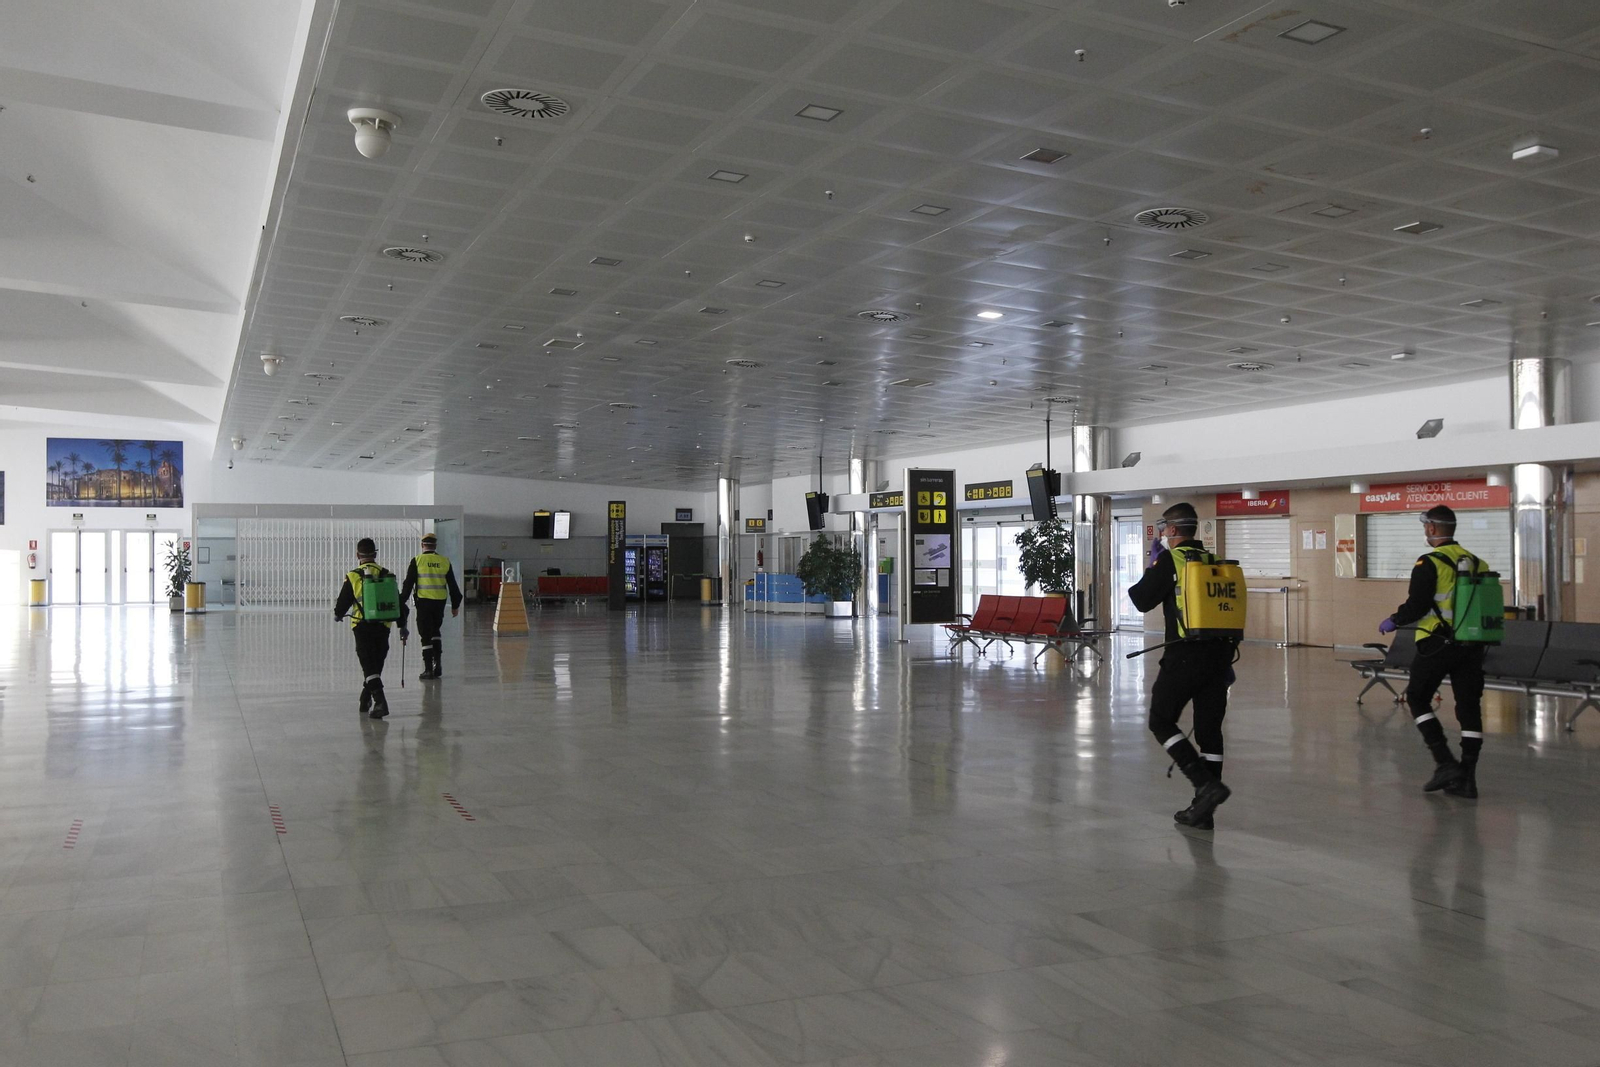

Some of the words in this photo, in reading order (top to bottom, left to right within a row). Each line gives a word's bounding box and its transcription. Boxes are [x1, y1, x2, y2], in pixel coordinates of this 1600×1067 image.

[1406, 483, 1439, 493] SERVICIO
[1440, 482, 1451, 492] DE
[1365, 491, 1401, 504] easyJet
[1406, 491, 1445, 503] ATENCIÓN
[1444, 492, 1455, 501] AL
[1456, 490, 1489, 501] CLIENTE
[1206, 582, 1237, 599] UME
[377, 602, 396, 611] UME
[1481, 615, 1505, 630] UME
